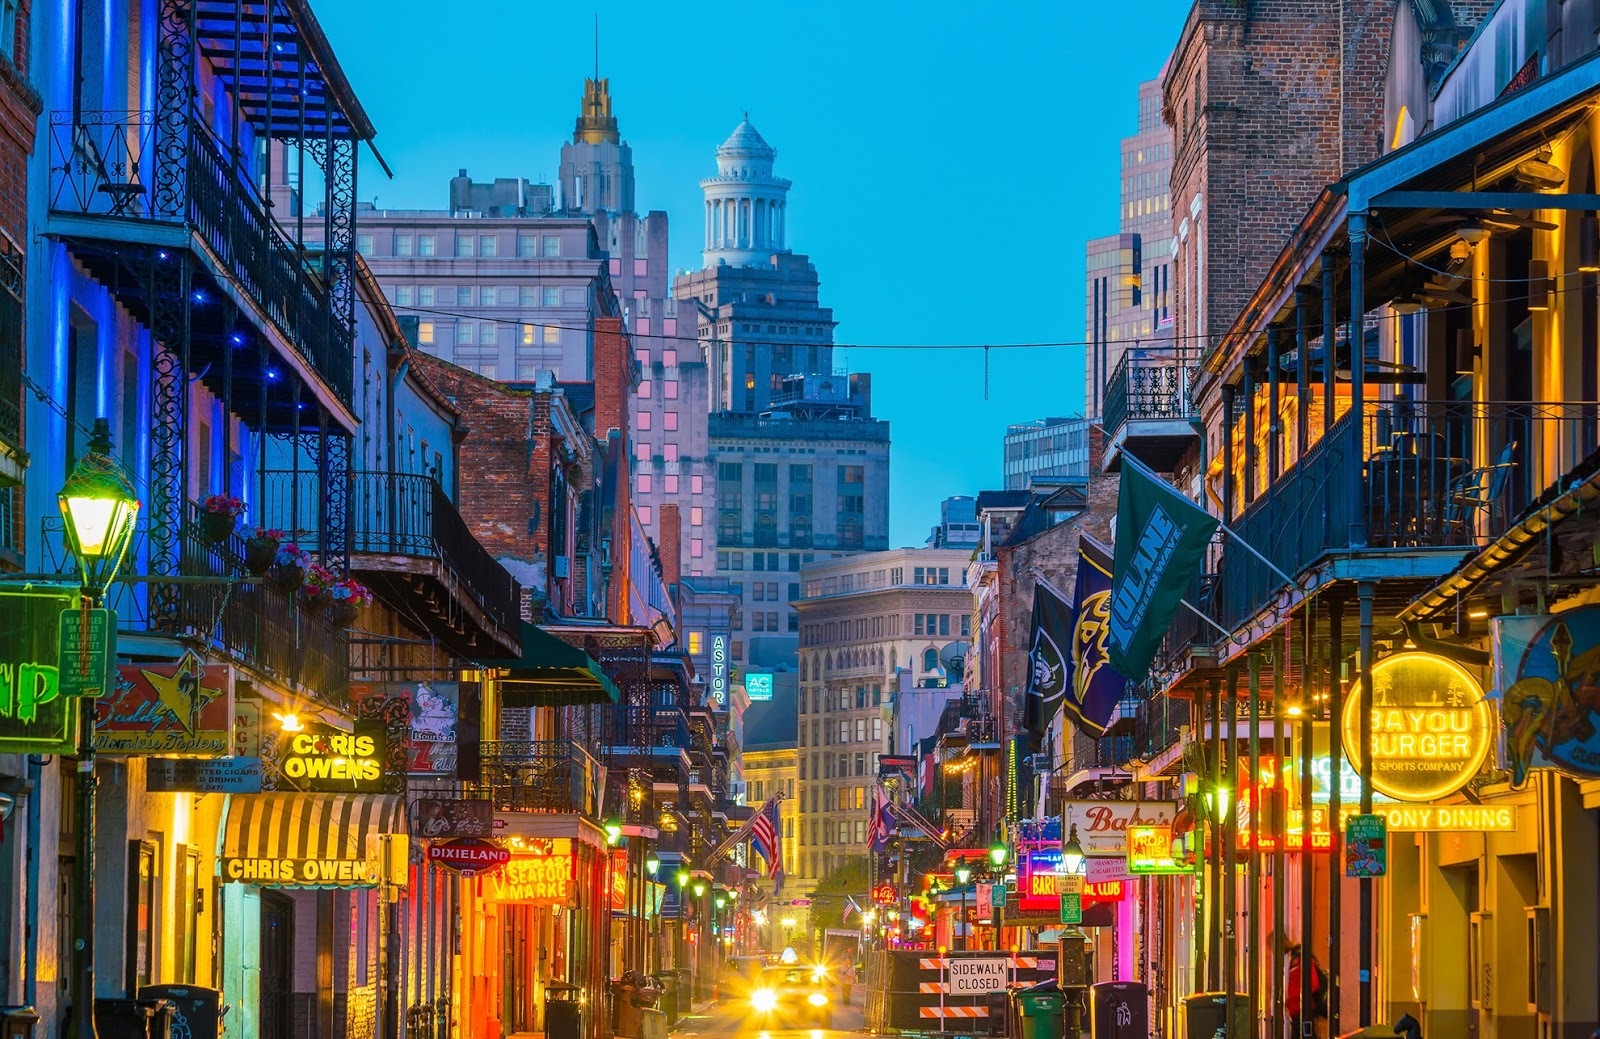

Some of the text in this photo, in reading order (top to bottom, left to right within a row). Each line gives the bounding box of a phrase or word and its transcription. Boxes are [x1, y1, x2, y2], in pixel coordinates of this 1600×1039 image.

[1110, 508, 1173, 651] TULANE
[1131, 575, 1159, 628] GREEN
[1155, 528, 1181, 576] WAVE
[76, 617, 102, 625] BTLES
[69, 633, 97, 641] ALLED
[77, 642, 99, 650] SEET
[713, 636, 724, 704] ASTOR
[749, 677, 769, 688] AC
[95, 734, 225, 752] ttomless Topless
[414, 732, 453, 741] Bourbon
[224, 768, 259, 776] CIGARS
[285, 757, 381, 781] OWENS
[1380, 762, 1416, 771] SPORTS
[1417, 762, 1462, 772] COMPANY
[1084, 806, 1169, 832] Babe's
[1439, 810, 1510, 827] DINING
[431, 847, 508, 861] DIXIELAND
[228, 859, 294, 879] CHRIS
[303, 860, 366, 880] OWEN
[1092, 866, 1124, 875] CIGARETTES
[509, 881, 566, 900] MARKE
[952, 963, 1004, 976] SIDEWALK
[958, 978, 999, 990] CLOSED
